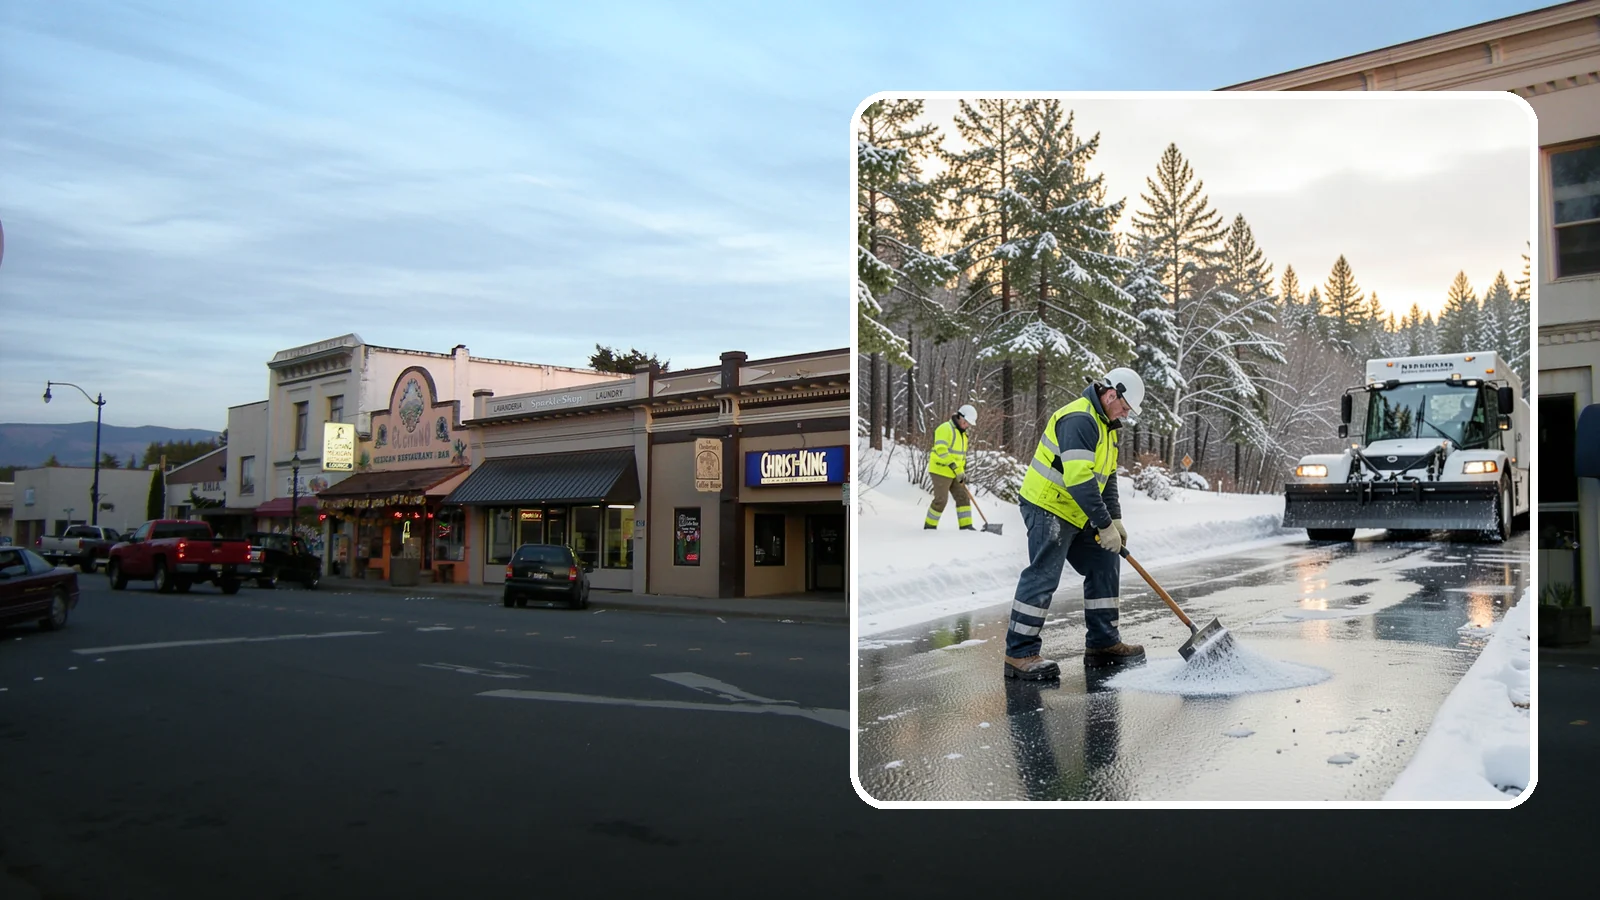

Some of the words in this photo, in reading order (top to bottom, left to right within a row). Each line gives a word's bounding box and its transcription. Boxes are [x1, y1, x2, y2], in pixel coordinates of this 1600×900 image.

[493, 402, 523, 413] LAVANDERIA
[531, 397, 562, 409] Sparkle
[562, 394, 584, 405] Shop
[595, 388, 624, 400] LAUNDRY
[373, 455, 397, 464] MEXICAN
[397, 451, 433, 463] RESTAURANT
[438, 450, 450, 460] BAR
[761, 452, 797, 478] CHRIST
[799, 450, 828, 477] KING
